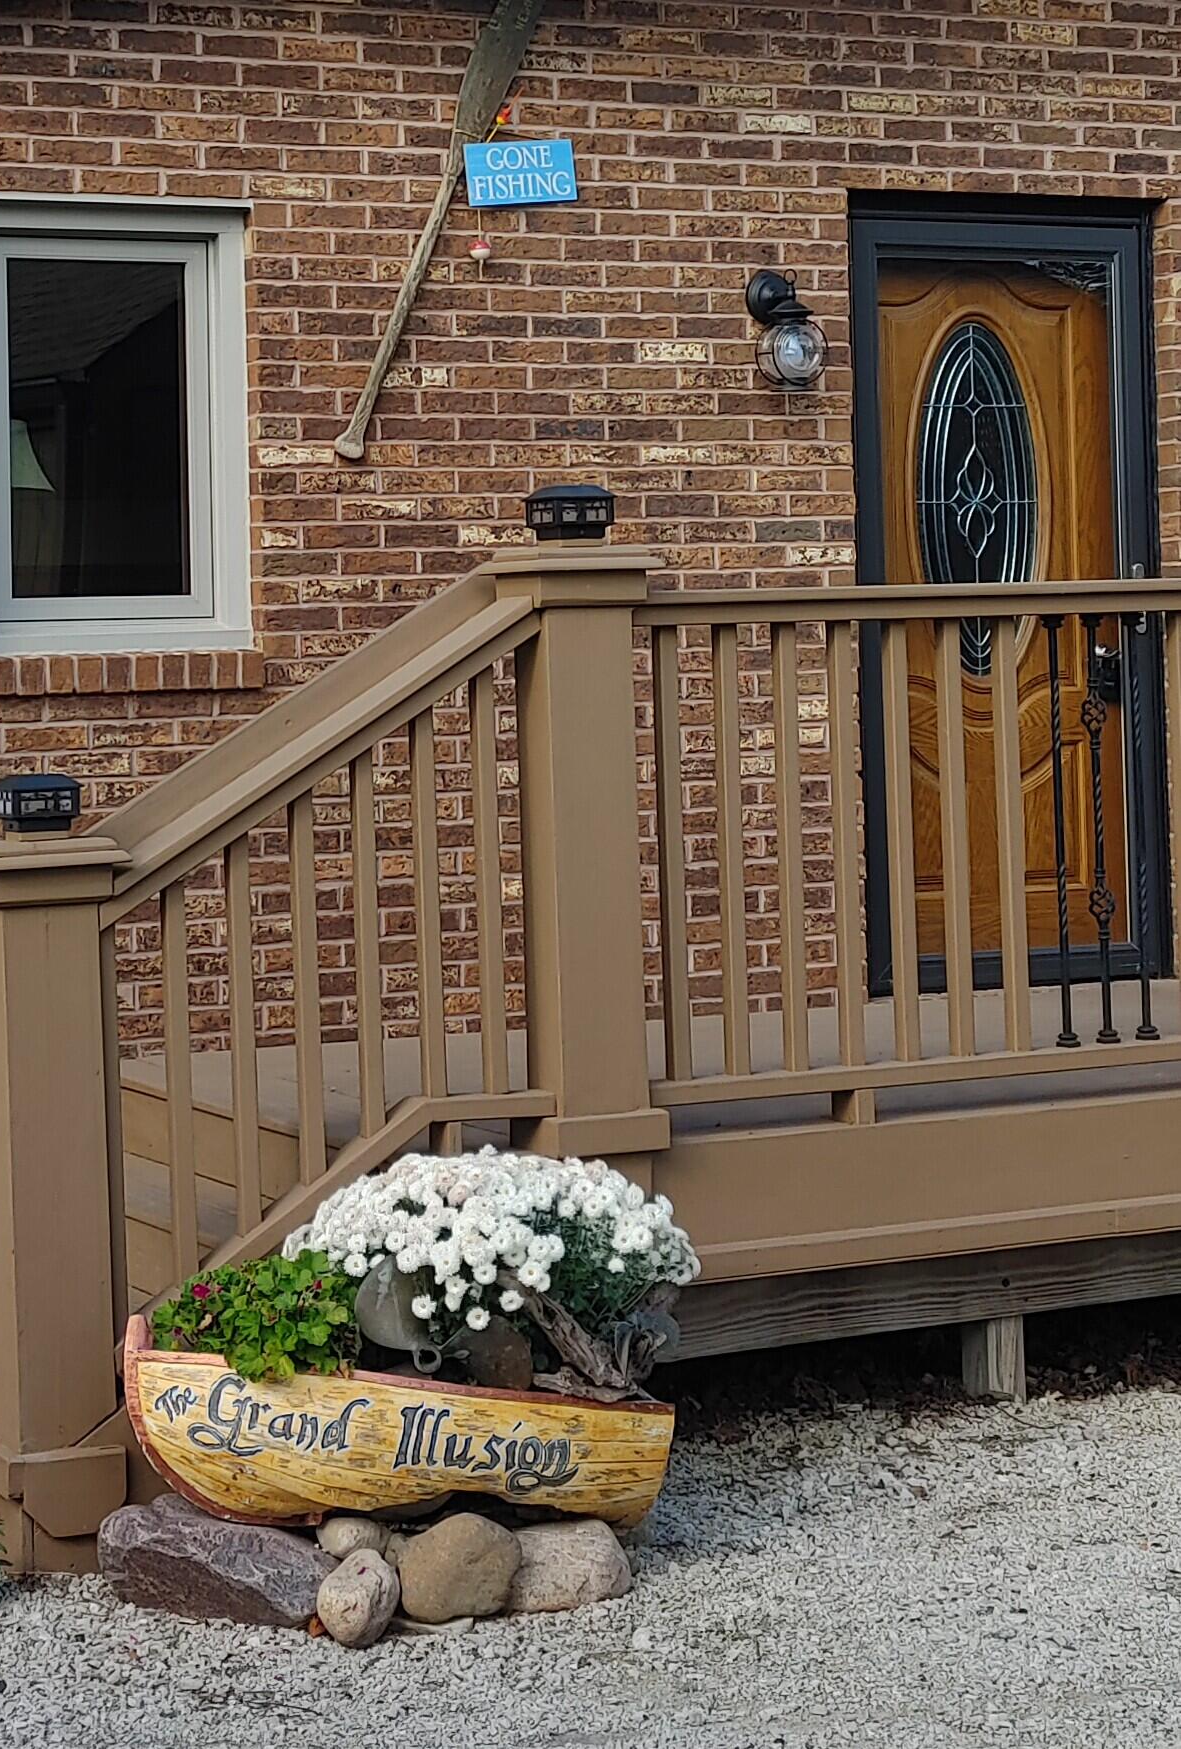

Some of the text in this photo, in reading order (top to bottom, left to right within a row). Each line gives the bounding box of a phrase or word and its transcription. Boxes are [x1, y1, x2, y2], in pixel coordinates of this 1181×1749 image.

[485, 145, 554, 171] GONE
[472, 171, 572, 201] FISHING
[154, 1372, 580, 1495] The Grand Illusion
